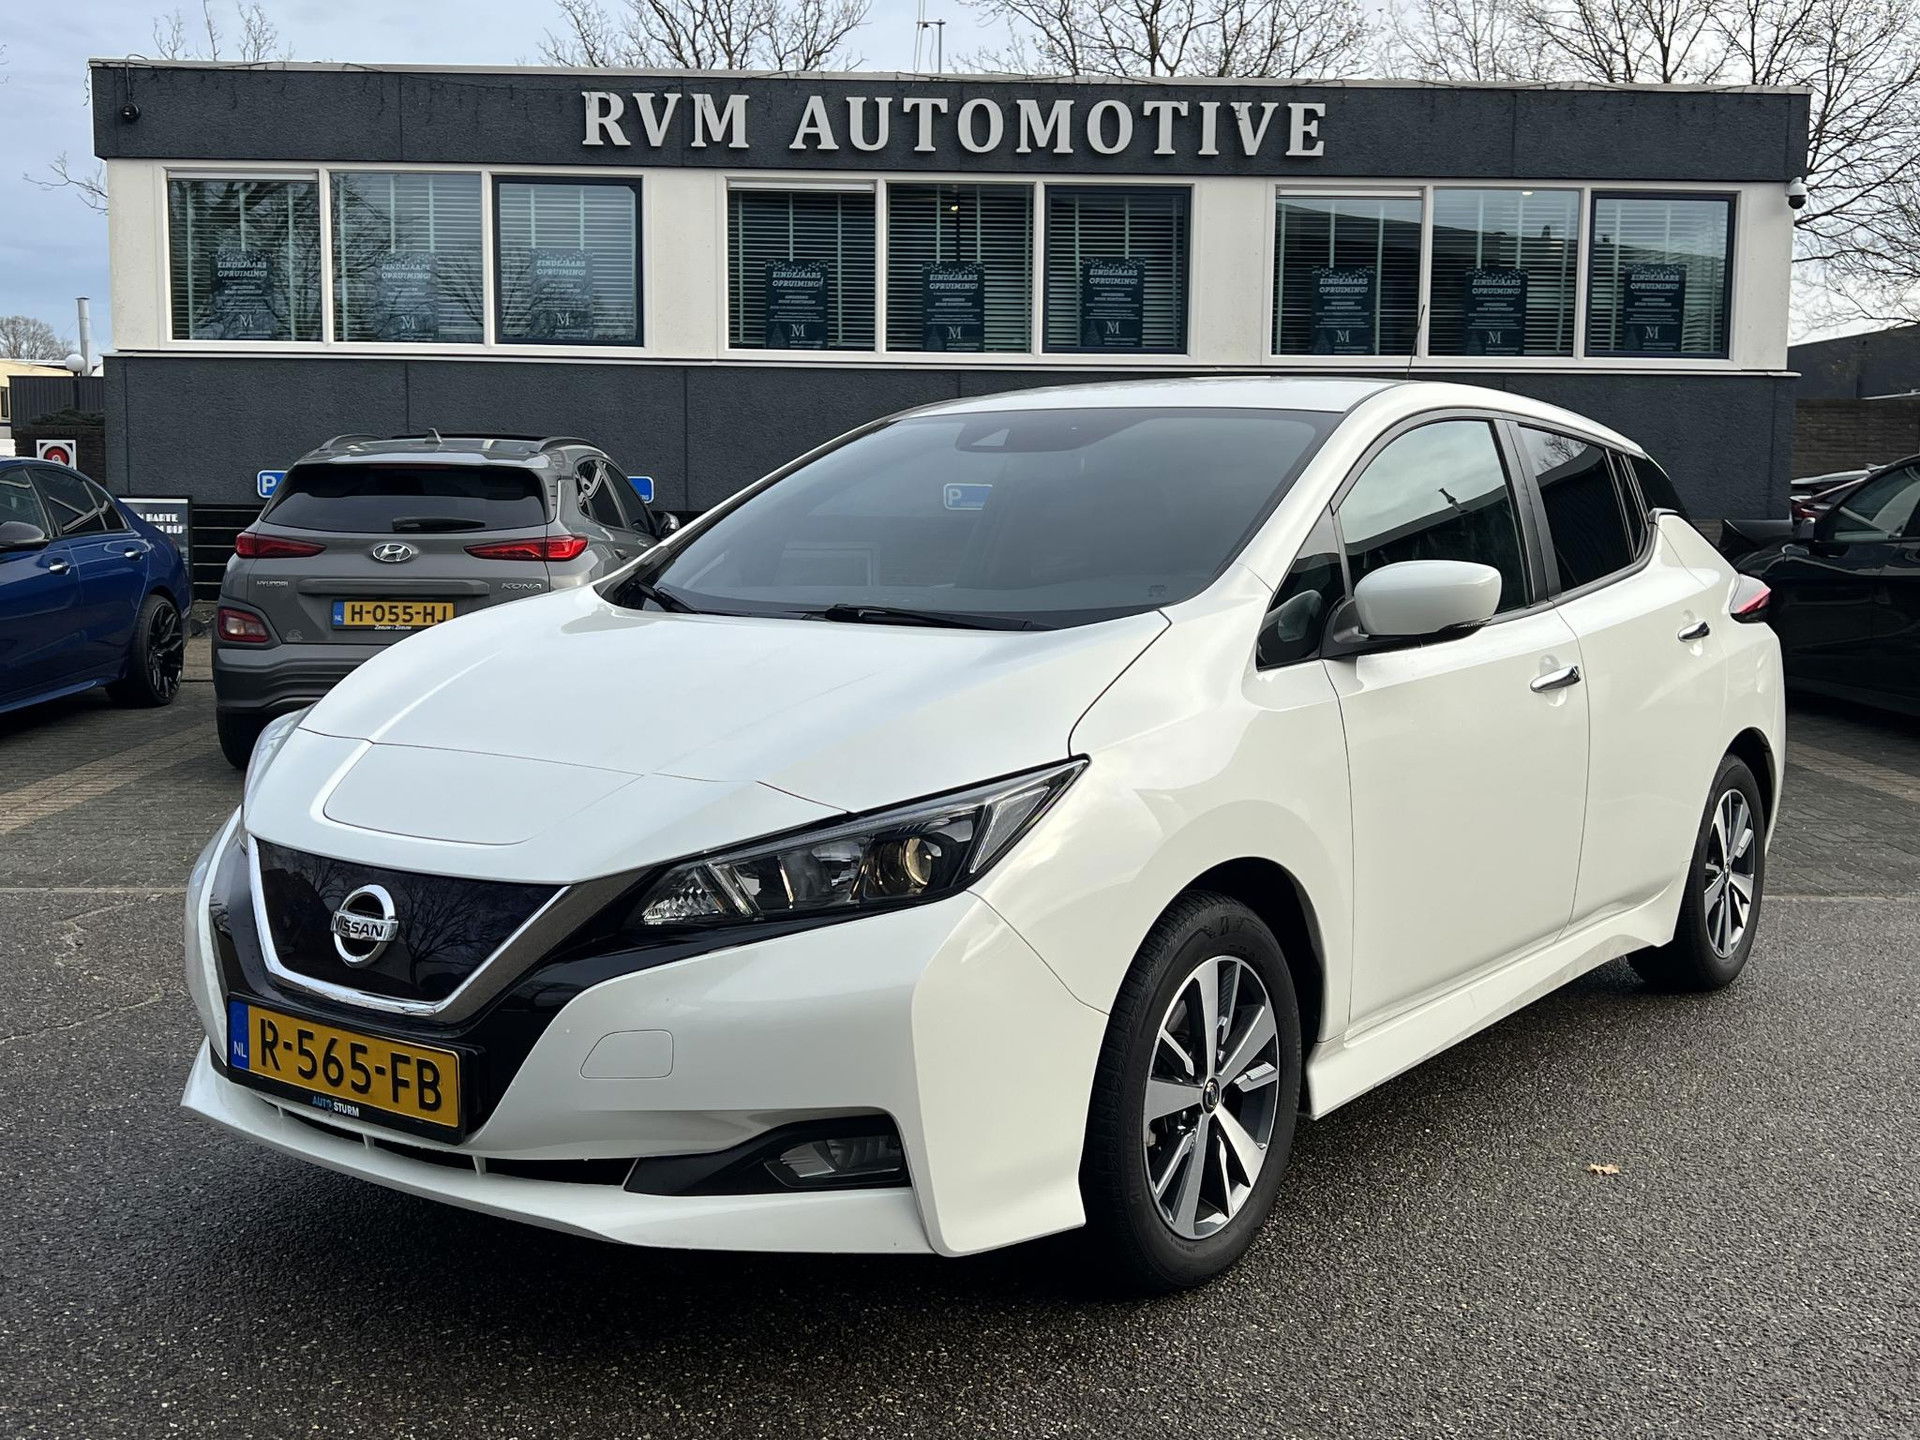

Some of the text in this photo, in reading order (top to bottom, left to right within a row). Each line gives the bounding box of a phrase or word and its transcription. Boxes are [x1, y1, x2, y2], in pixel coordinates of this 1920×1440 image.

[581, 91, 1326, 157] RVM AUTOMOTIVE
[261, 475, 277, 494] P
[501, 582, 542, 590] KONA
[351, 604, 447, 623] H-055-HJ
[331, 914, 385, 938] NISSAN
[233, 1017, 443, 1113] NL R-565-FB
[333, 1101, 360, 1118] STURM
